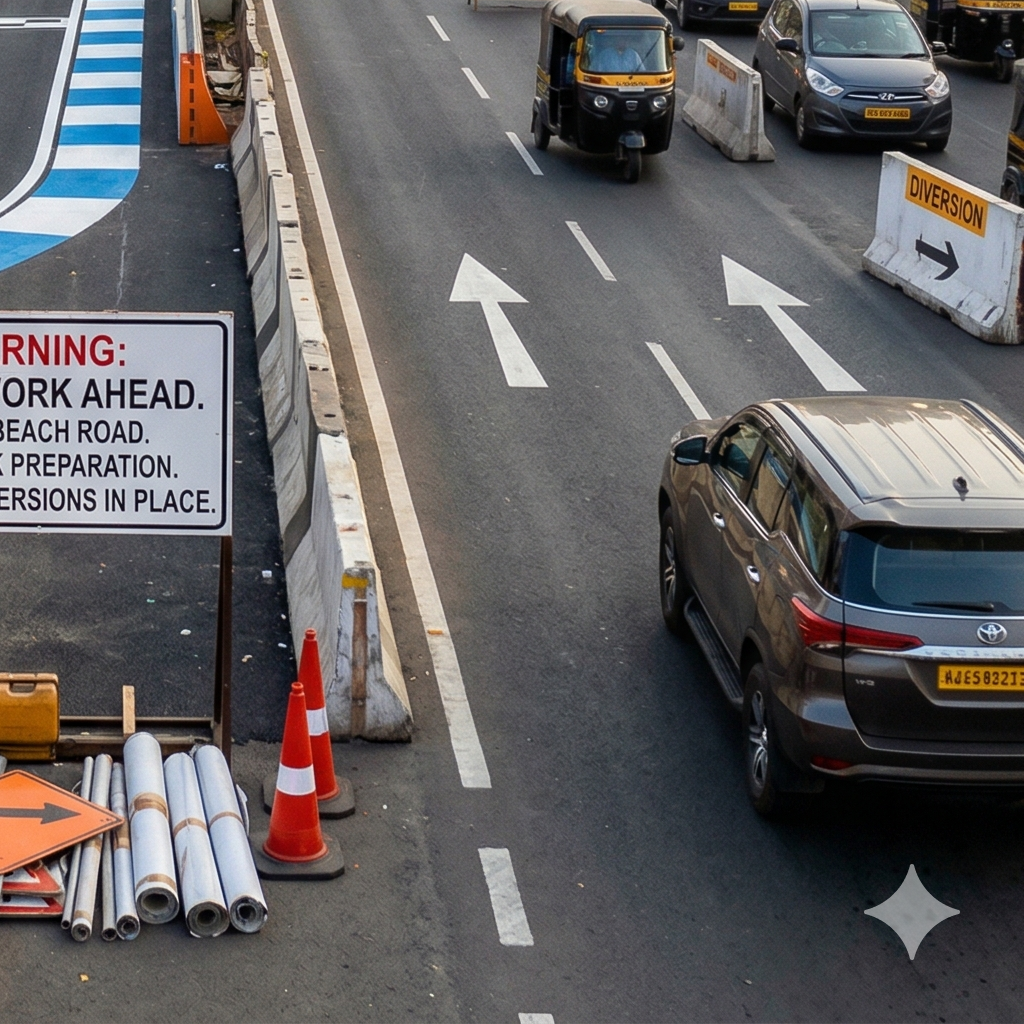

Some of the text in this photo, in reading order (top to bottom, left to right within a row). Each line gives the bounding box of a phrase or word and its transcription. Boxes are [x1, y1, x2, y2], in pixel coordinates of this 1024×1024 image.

[909, 174, 984, 230] DIVERSION
[81, 378, 204, 410] AHEAD.
[78, 419, 150, 444] ROAD.
[12, 453, 178, 479] PREPARATION.
[106, 488, 126, 512] IN
[135, 488, 216, 514] PLACE.
